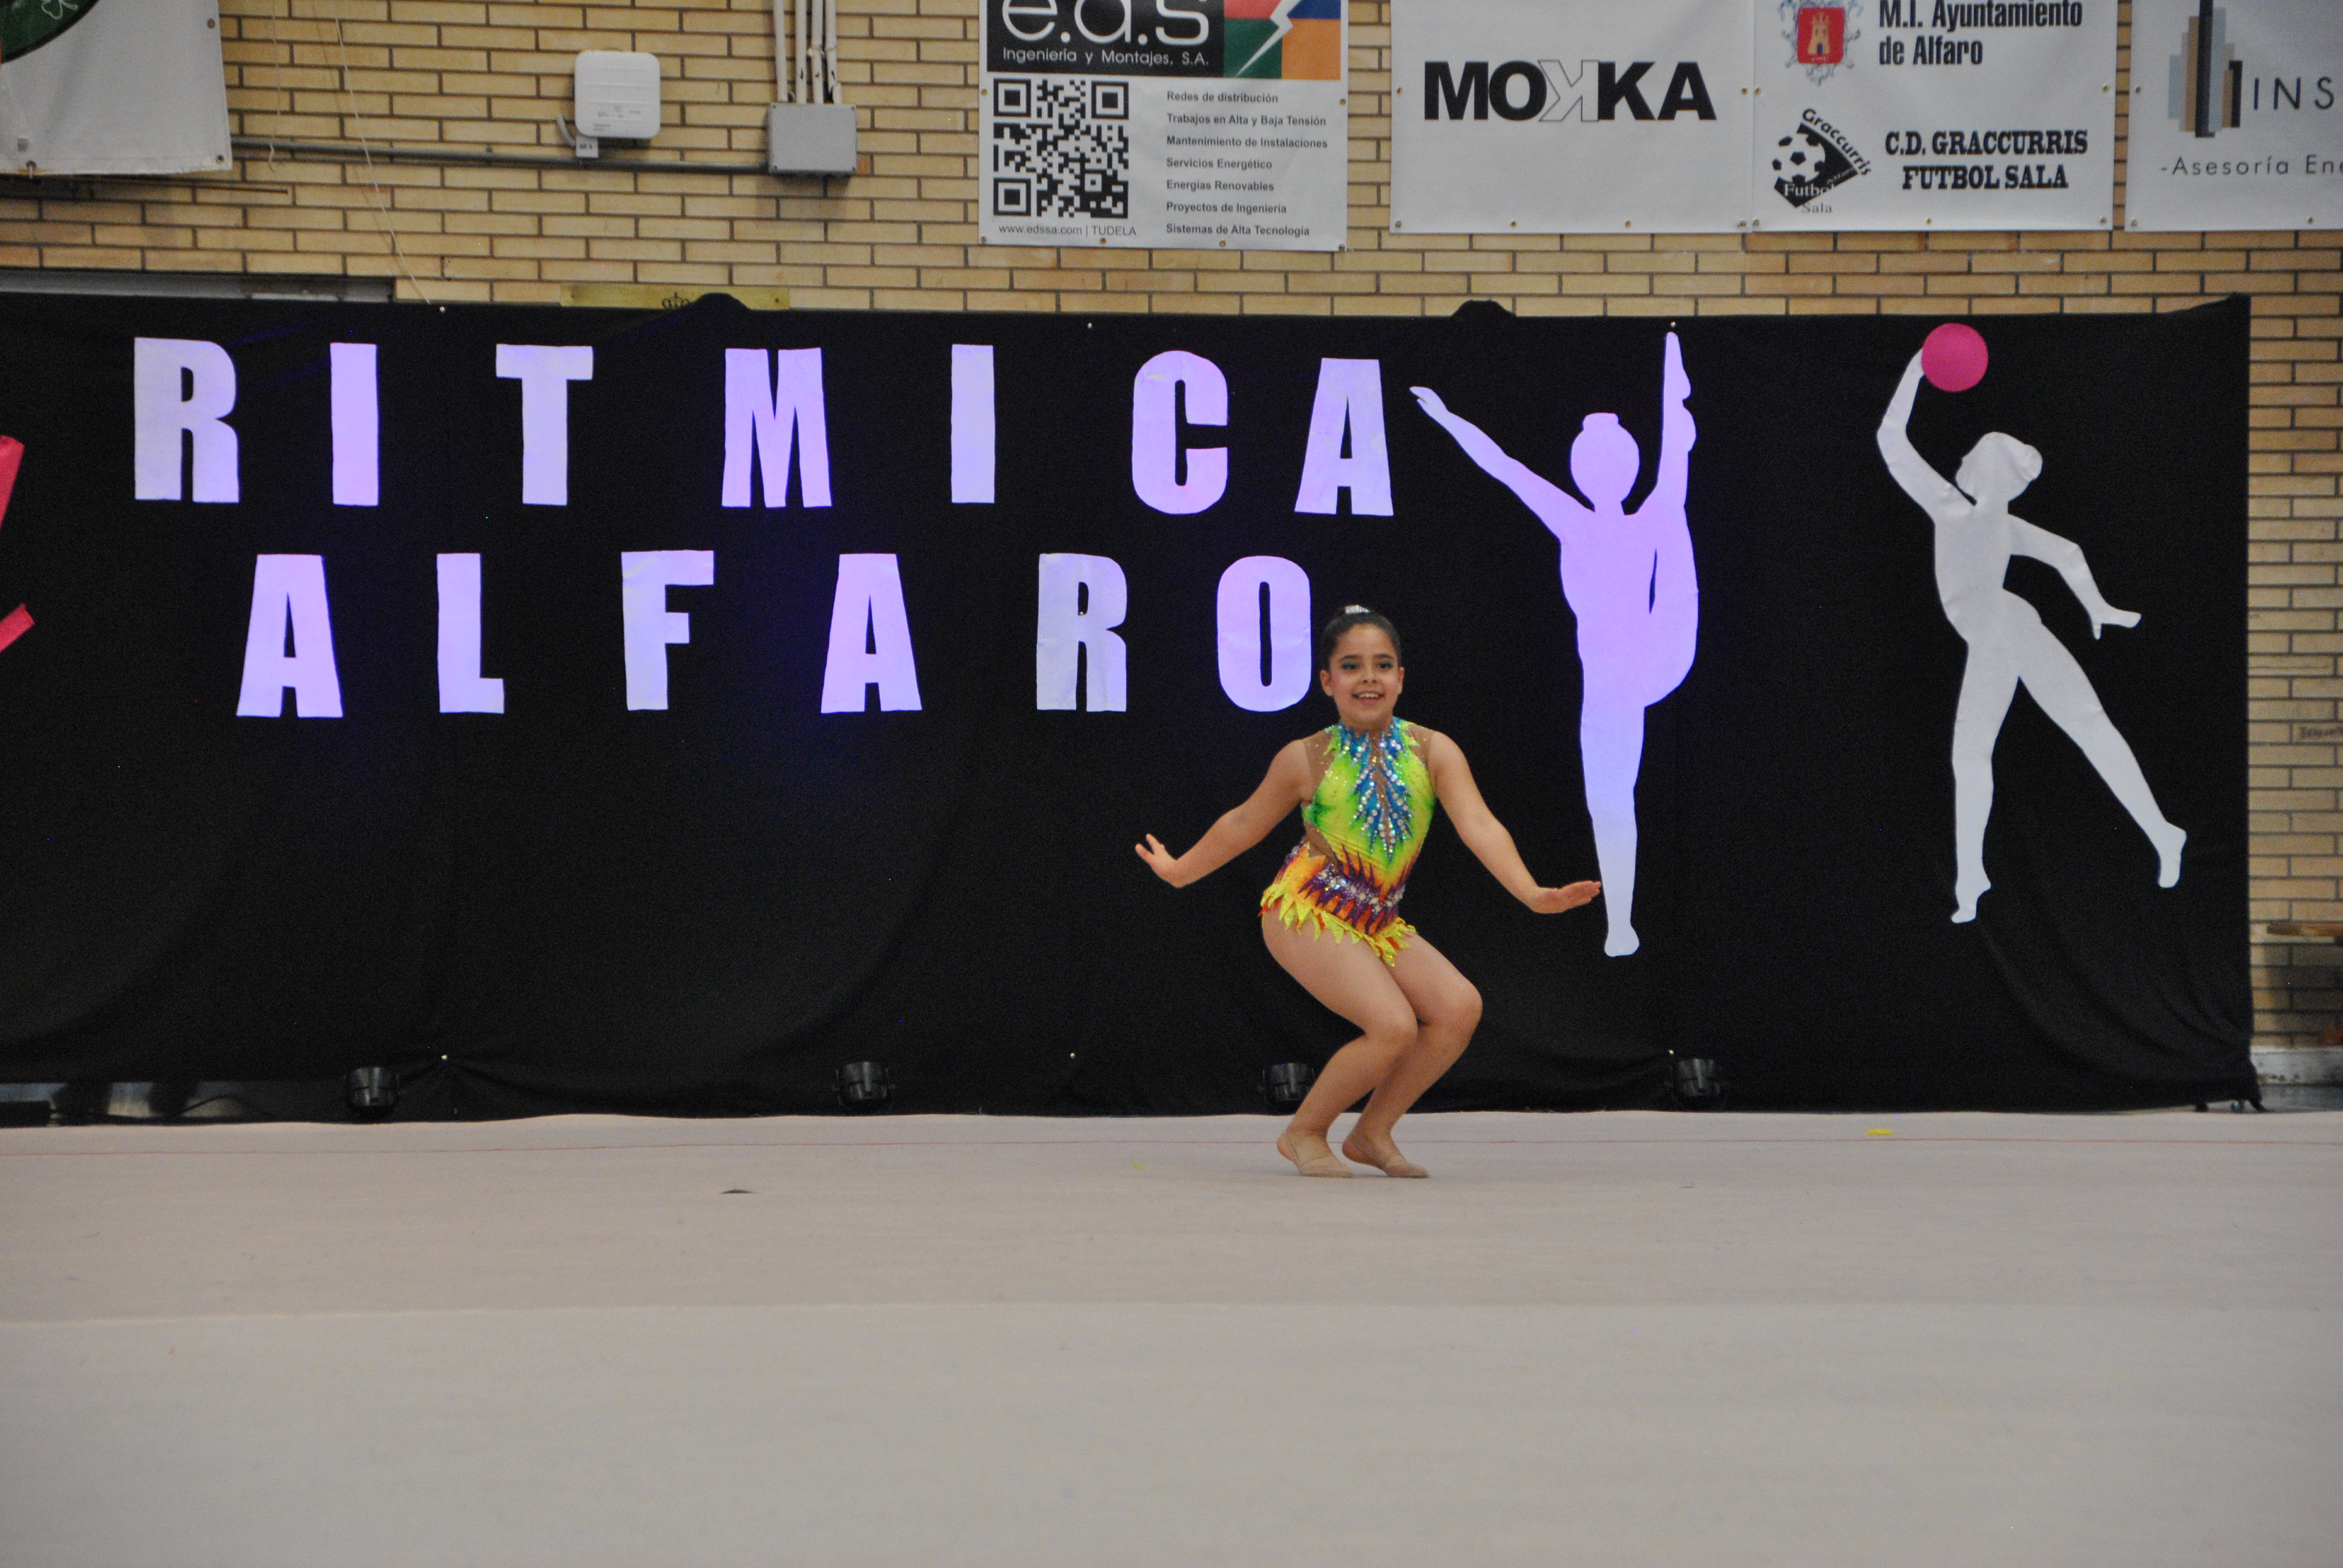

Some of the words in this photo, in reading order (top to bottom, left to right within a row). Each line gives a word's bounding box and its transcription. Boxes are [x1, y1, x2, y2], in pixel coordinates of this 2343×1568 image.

[1932, 0, 2083, 33] Ayuntamiento
[1003, 47, 1077, 64] Ingeniería
[1085, 52, 1093, 65] y
[1879, 35, 1904, 65] de
[1913, 35, 1984, 65] Alfaro
[1167, 92, 1199, 102] Redes
[1202, 93, 1214, 102] de
[1217, 93, 1279, 103] distribución
[2253, 77, 2335, 110] INS
[1167, 113, 1210, 126] Trabajos
[1228, 114, 1248, 125] Alta
[1251, 118, 1259, 127] y
[1260, 115, 1283, 127] Baja
[1286, 116, 1326, 126] Tensión
[1167, 136, 1242, 147] Mantenimiento
[1245, 137, 1257, 147] de
[1260, 137, 1328, 148] Instalaciones
[1802, 108, 1872, 177] Graccurris
[1885, 131, 1927, 155] C.D.
[1932, 129, 2089, 155] GRACCURRIS
[1167, 157, 1214, 168] Servicios
[1217, 158, 1273, 171] Energético
[1167, 179, 1211, 192] Energías
[1214, 181, 1274, 191] Renovables
[1902, 165, 1999, 190] FUTBOL
[2005, 163, 2069, 189] SALA
[1167, 201, 1217, 214] Proyectos
[1221, 203, 1233, 212] de
[1236, 203, 1287, 215] Ingeniería
[998, 224, 1083, 235] www.edssa.com
[1092, 225, 1137, 236] TUDELA
[1167, 223, 1213, 234] Sistemas
[1216, 224, 1228, 235] de
[1231, 224, 1251, 235] Alta
[1254, 225, 1310, 238] Tecnología
[134, 336, 1394, 516] RITMICA
[237, 550, 1312, 717] ALFARO
